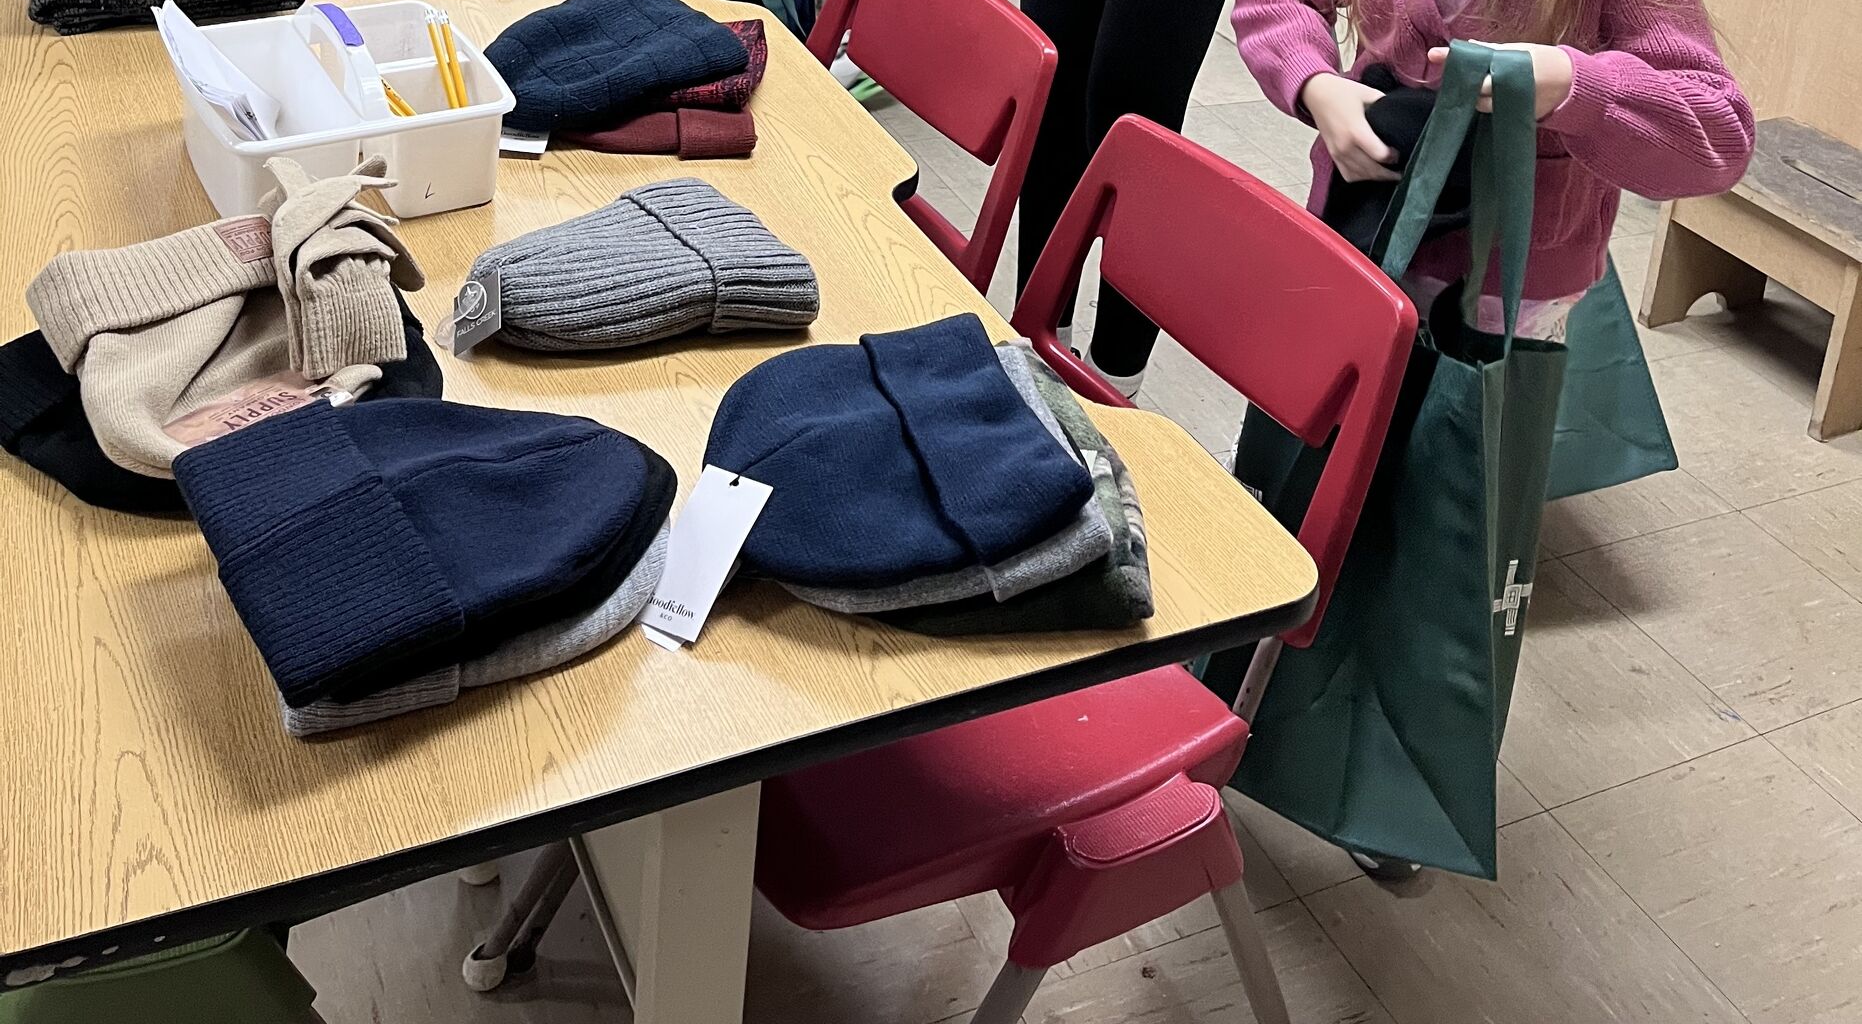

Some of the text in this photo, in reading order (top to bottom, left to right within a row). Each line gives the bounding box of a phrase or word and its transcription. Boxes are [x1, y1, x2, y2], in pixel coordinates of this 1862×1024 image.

[456, 309, 496, 338] FALLS CREEK
[222, 391, 297, 431] SUPPLY
